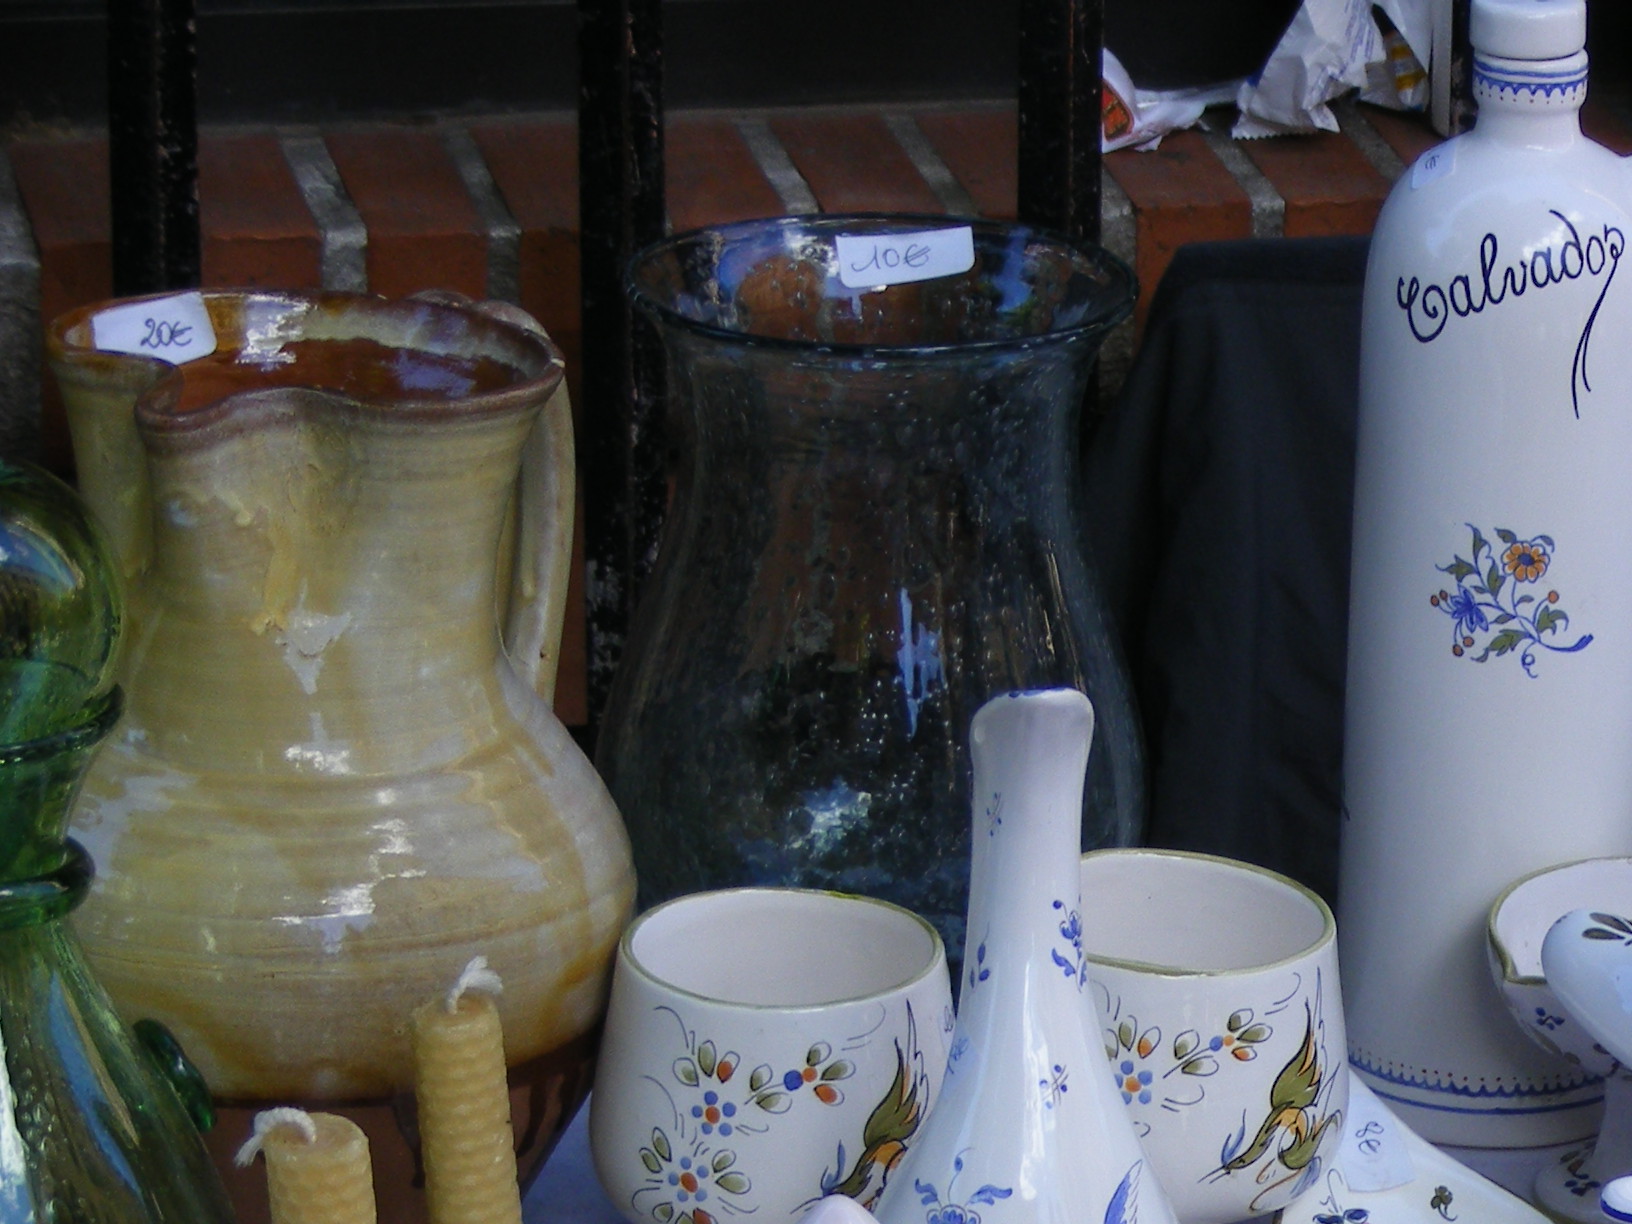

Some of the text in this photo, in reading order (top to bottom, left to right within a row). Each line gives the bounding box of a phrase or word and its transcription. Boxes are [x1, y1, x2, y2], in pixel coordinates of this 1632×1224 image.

[850, 243, 931, 273] 10€
[1396, 209, 1626, 420] Calvados
[140, 317, 193, 349] 20€
